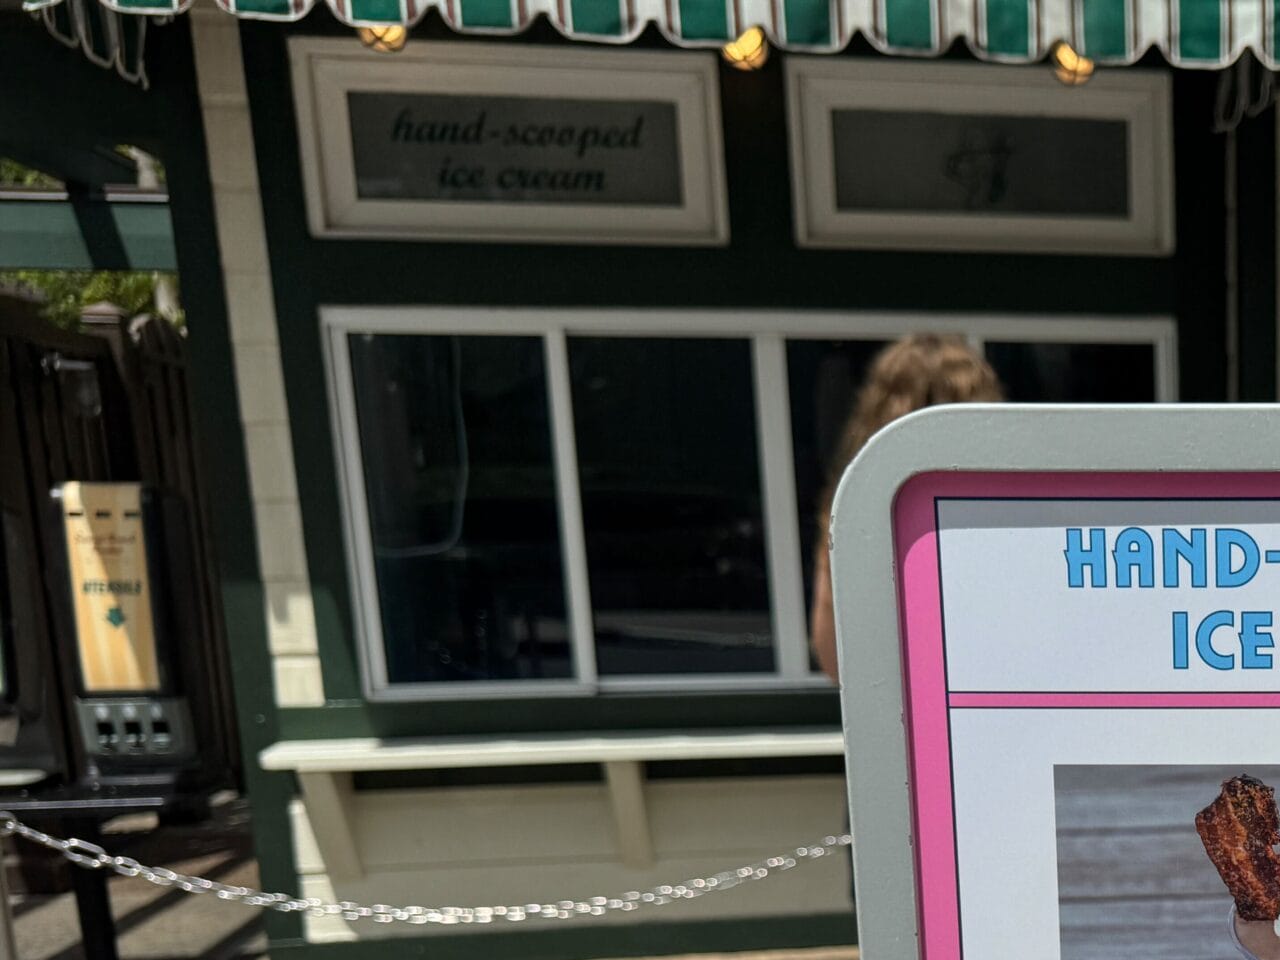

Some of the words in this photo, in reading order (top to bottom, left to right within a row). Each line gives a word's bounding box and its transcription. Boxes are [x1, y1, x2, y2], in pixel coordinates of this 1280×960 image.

[390, 107, 645, 157] hand-scooped
[438, 157, 486, 190] ice
[496, 167, 606, 191] cream
[1172, 610, 1275, 670] ICE
